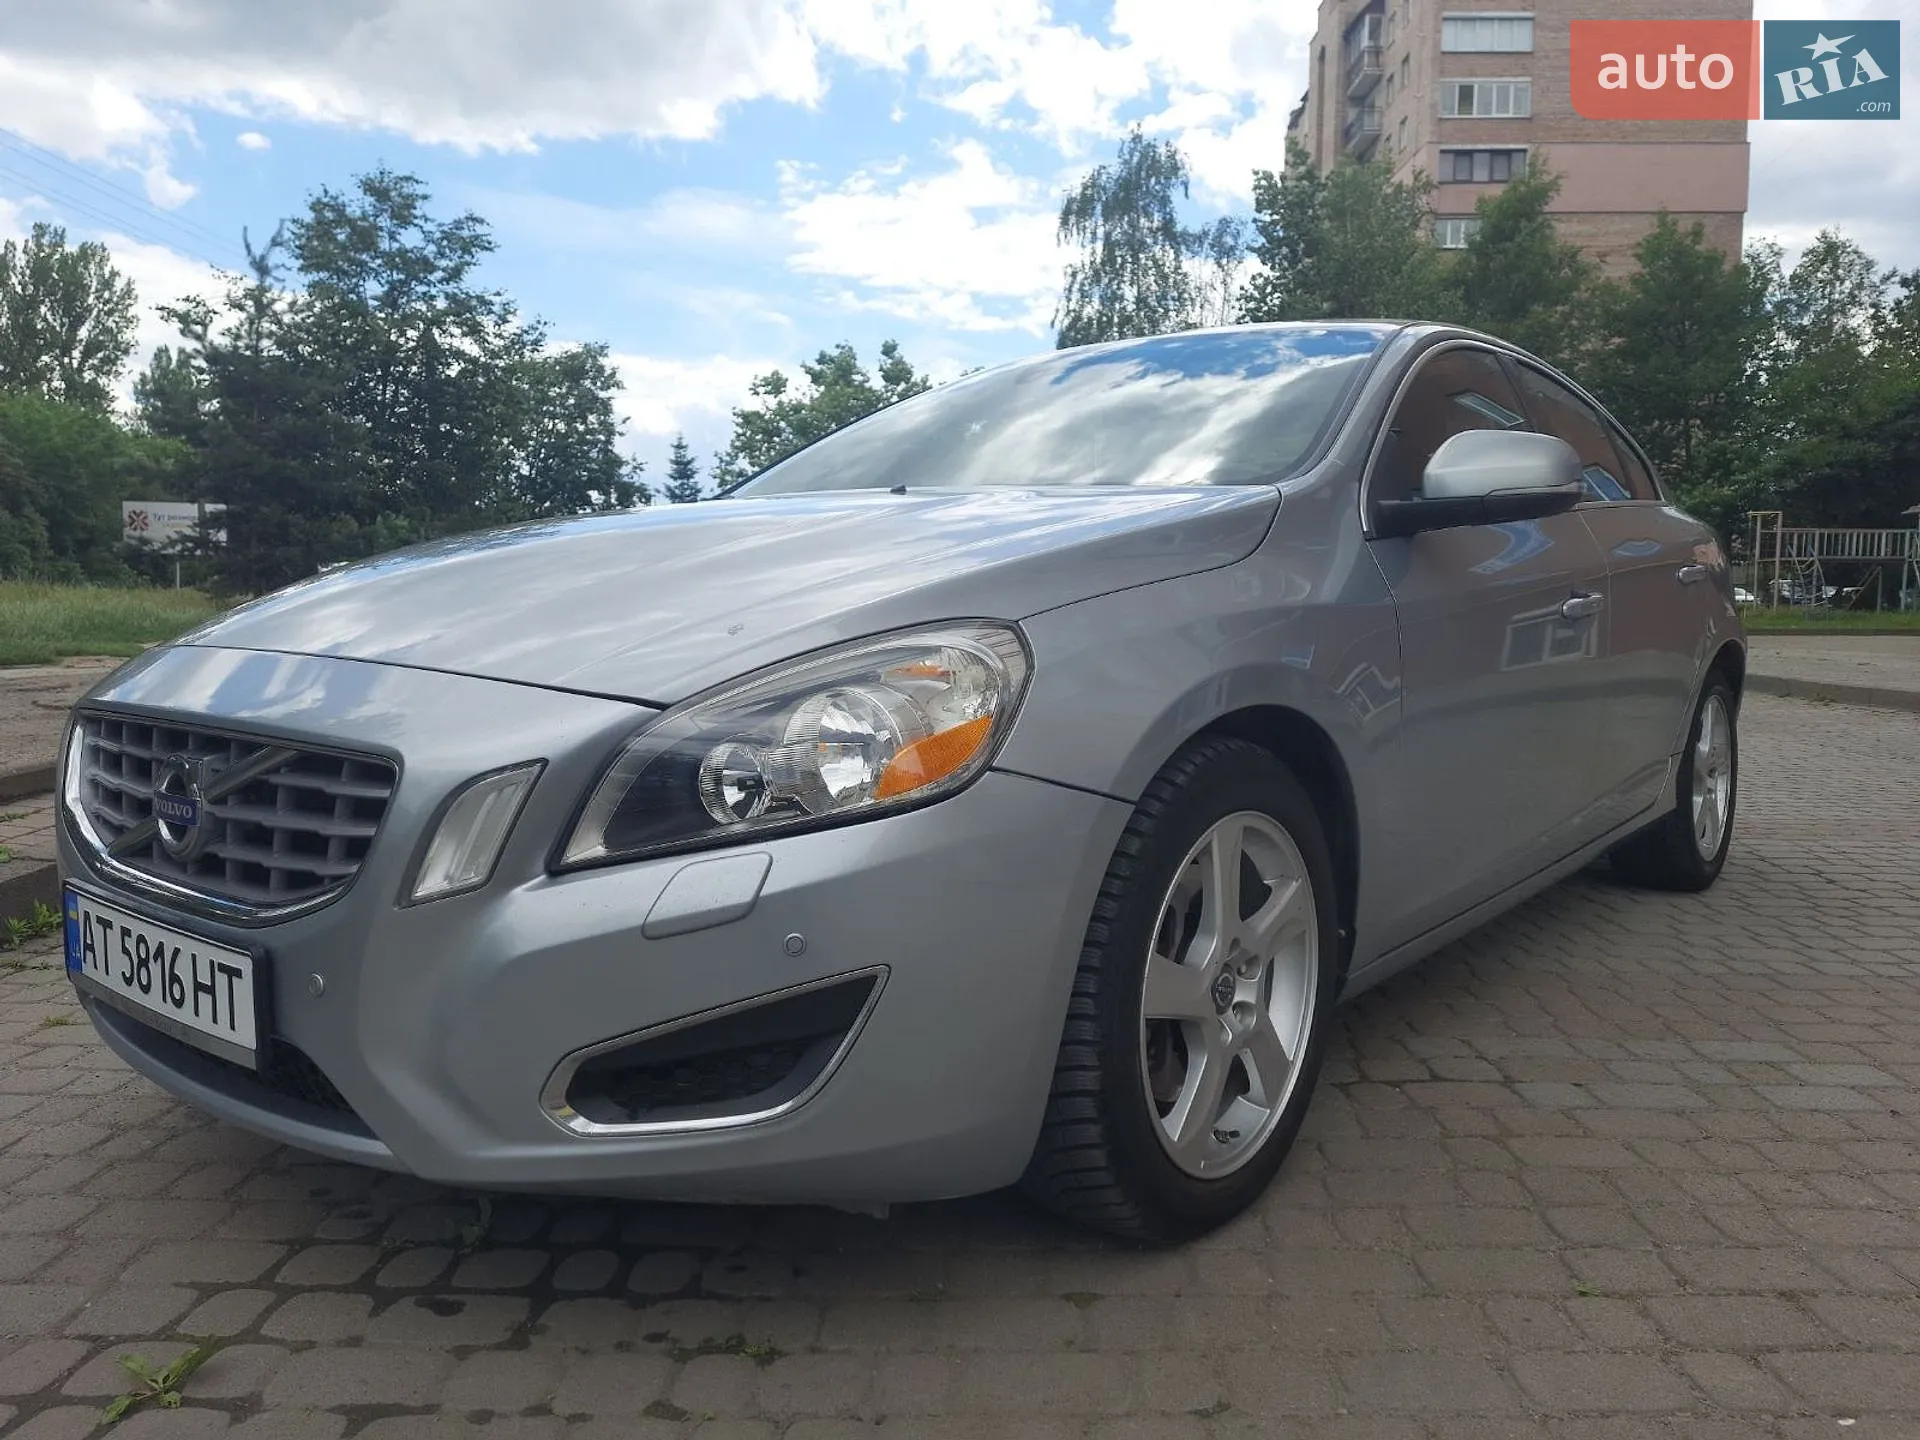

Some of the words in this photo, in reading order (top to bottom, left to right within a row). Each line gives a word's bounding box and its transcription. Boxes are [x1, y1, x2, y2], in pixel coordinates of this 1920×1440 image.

[155, 800, 193, 818] VOLVO
[82, 910, 113, 976] AT
[120, 925, 186, 1009] 5816
[191, 952, 243, 1031] HT
